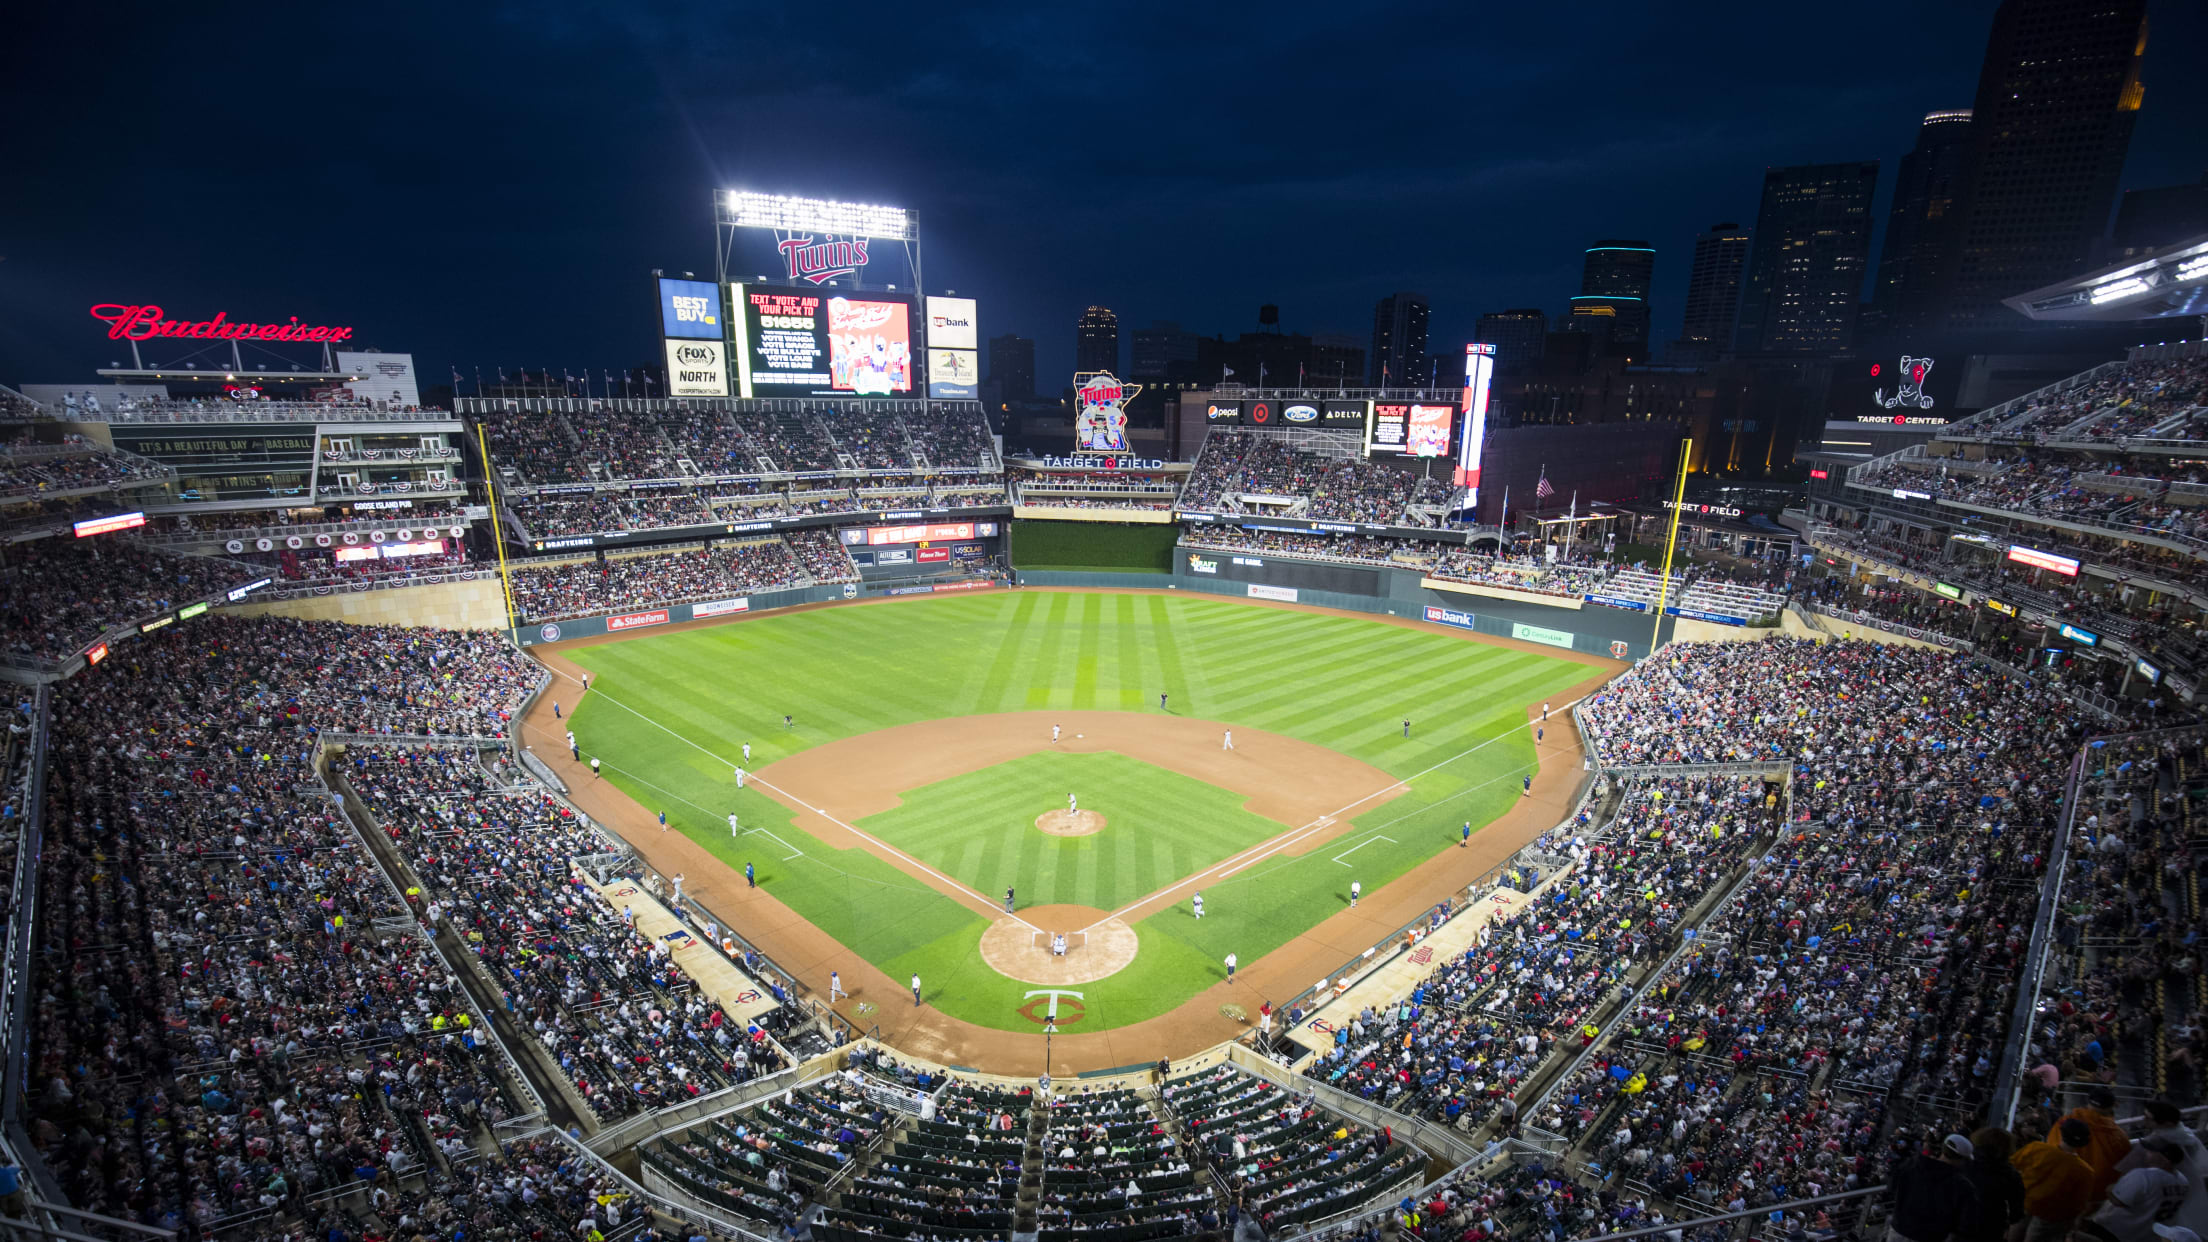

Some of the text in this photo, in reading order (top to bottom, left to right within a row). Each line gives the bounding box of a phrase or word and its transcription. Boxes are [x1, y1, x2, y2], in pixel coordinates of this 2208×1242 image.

[778, 233, 869, 280] Twins
[672, 295, 709, 309] BEST
[750, 294, 819, 307] TEXT "VOTE" AND
[676, 308, 707, 322] BUY
[759, 304, 814, 316] YOUR PICK TO
[90, 303, 352, 343] Budweiser
[760, 315, 815, 329] 51655
[684, 347, 708, 359] FOX
[680, 370, 716, 382] NORTH
[1079, 384, 1122, 406] Twins
[1218, 407, 1239, 417] pepsi
[1334, 410, 1362, 418] DELTA
[1857, 415, 1945, 425] TARGET CENTER
[138, 441, 162, 452] IT'S
[165, 441, 172, 451] A
[174, 440, 229, 451] BEAUTIFUL
[230, 440, 248, 450] DAY
[265, 438, 311, 450] BASEBALL
[1044, 458, 1163, 469] TARGET FIELD
[224, 474, 257, 488] TWINS
[354, 500, 412, 511] GOOSE ISLAND PUB
[1710, 505, 1741, 517] FIELD
[1193, 559, 1218, 568] DRAFT
[706, 601, 735, 612] BUDWEISER
